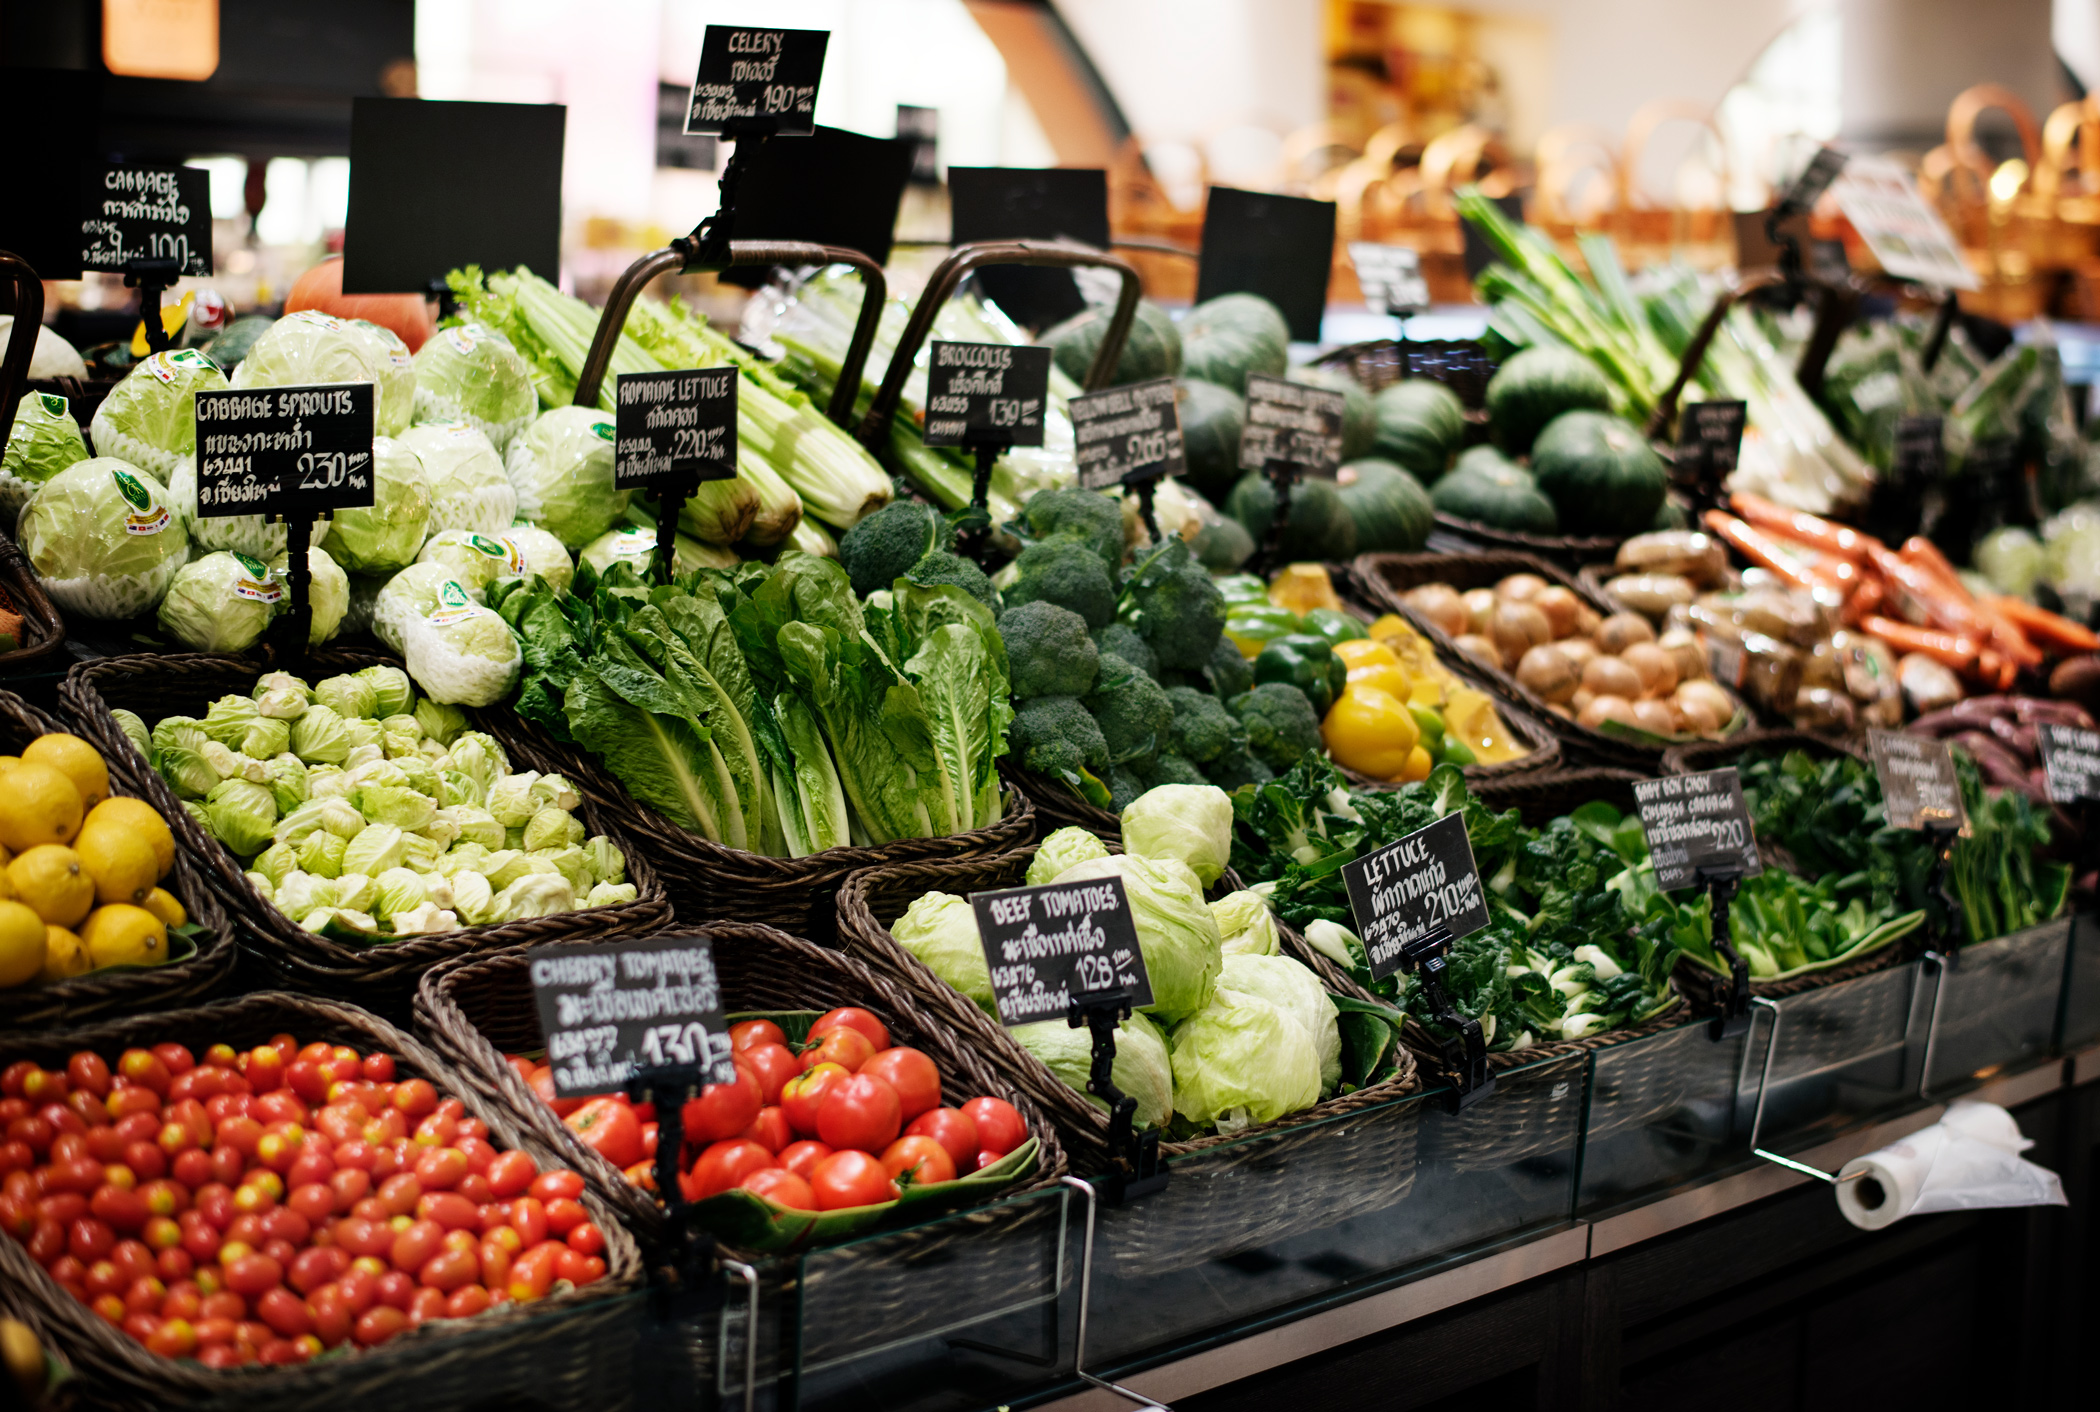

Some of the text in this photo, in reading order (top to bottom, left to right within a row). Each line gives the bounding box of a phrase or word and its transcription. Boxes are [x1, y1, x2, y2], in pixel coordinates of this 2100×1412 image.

[728, 32, 784, 54] CELERY
[763, 84, 795, 114] 190
[105, 170, 178, 194] CABBAGE
[619, 376, 729, 406] ROMAINE LETTUCE
[197, 395, 273, 421] CABBAGE
[989, 399, 1020, 426] 139
[296, 452, 347, 490] 230
[1710, 819, 1744, 851] 220
[1363, 836, 1429, 886] LETTUCE
[989, 896, 1033, 926] BEEF
[530, 953, 617, 987] CHERRY
[1075, 954, 1114, 990] 128
[641, 1021, 712, 1074] 130
